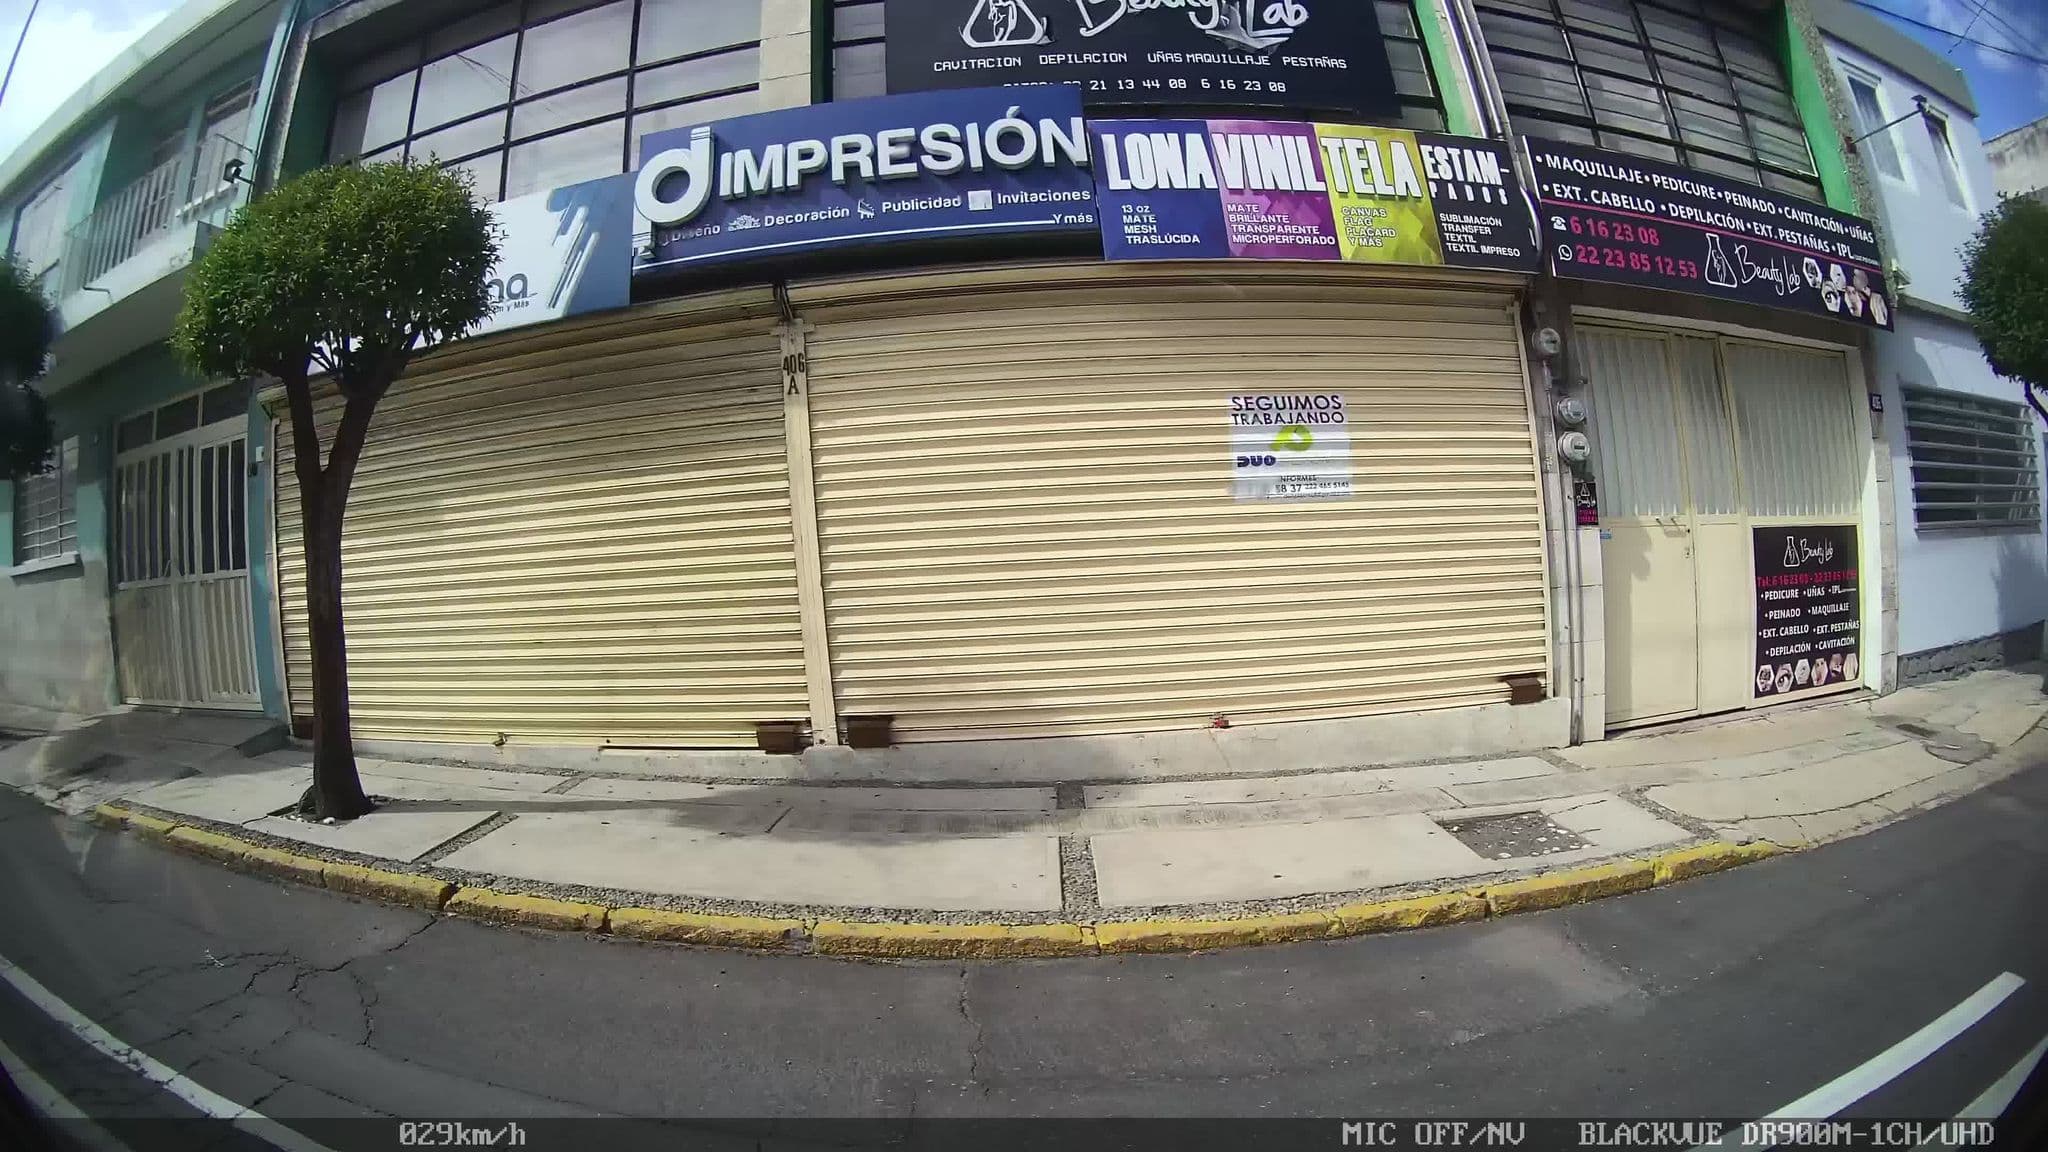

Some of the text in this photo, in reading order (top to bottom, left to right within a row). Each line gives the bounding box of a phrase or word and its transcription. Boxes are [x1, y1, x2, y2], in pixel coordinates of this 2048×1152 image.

[934, 51, 1348, 72] CAVITACION DEPILACION UÑAS MAQUILLAJE PESTAÑAS
[1090, 80, 1107, 90] 21
[1118, 80, 1135, 90] 13
[1142, 79, 1160, 89] 44
[1169, 79, 1187, 89] 08
[1201, 79, 1211, 89] 6
[1220, 80, 1236, 90] 16
[1243, 80, 1261, 91] 23
[1269, 81, 1287, 92] 08
[718, 106, 1089, 199] IMPRESIÓN
[1100, 133, 1220, 191] LONA
[1211, 133, 1327, 192] VINIL
[1320, 137, 1423, 198] TELA
[1545, 154, 1874, 244] MAQUILLAJE PEDICURE PEINADO CAVITACIÓN UÑAS
[764, 206, 850, 228] Decoración
[882, 195, 962, 213] Publicidad
[998, 189, 1091, 205] Invitaciones
[1121, 205, 1134, 213] 13
[1228, 205, 1260, 213] MATE
[1342, 207, 1387, 217] CANVAS
[1053, 211, 1094, 224] Y más
[1123, 215, 1157, 224] MATE
[1229, 215, 1290, 224] BRILLANTE
[1344, 217, 1373, 227] FLAG
[1440, 212, 1503, 227] SUBLIMACIÓN
[1552, 183, 1854, 259] EXT. CABELLO DEPILACIÓN EXT. PESTAÑAS IPL
[1124, 225, 1157, 234] MESH
[1231, 225, 1320, 235] TRANSPARENTE
[1346, 226, 1397, 238] PLACARD
[1442, 223, 1492, 235] TRANSFER
[1569, 215, 1660, 246] 6 16 23 08
[1126, 232, 1201, 245] TRASLÚCIDA
[1232, 235, 1336, 246] MICROPERFORADO
[1444, 233, 1477, 244] TEXTIL
[1446, 242, 1521, 257] TEXTIL IMPRESO
[1576, 244, 1600, 265] 22
[1603, 248, 1626, 268] 23
[1655, 255, 1676, 276] 12
[1678, 259, 1698, 280] 53
[1735, 242, 1800, 296] Beauty Lab
[782, 353, 805, 376] 406
[787, 375, 800, 395] A
[1231, 395, 1342, 411] SEGUIMOS
[1231, 411, 1345, 426] TRABAJANDO
[1765, 589, 1799, 601] PEDICURE
[1807, 586, 1825, 597] UÑAS
[1769, 602, 1850, 620] PEINADO MAQUILLAJE
[1762, 628, 1778, 639] EXT.
[1779, 624, 1809, 637] CABELLO
[1830, 619, 1860, 633] PESTAÑAS
[1770, 635, 1855, 657] DEPILACIÓN CAVITACIÓN
